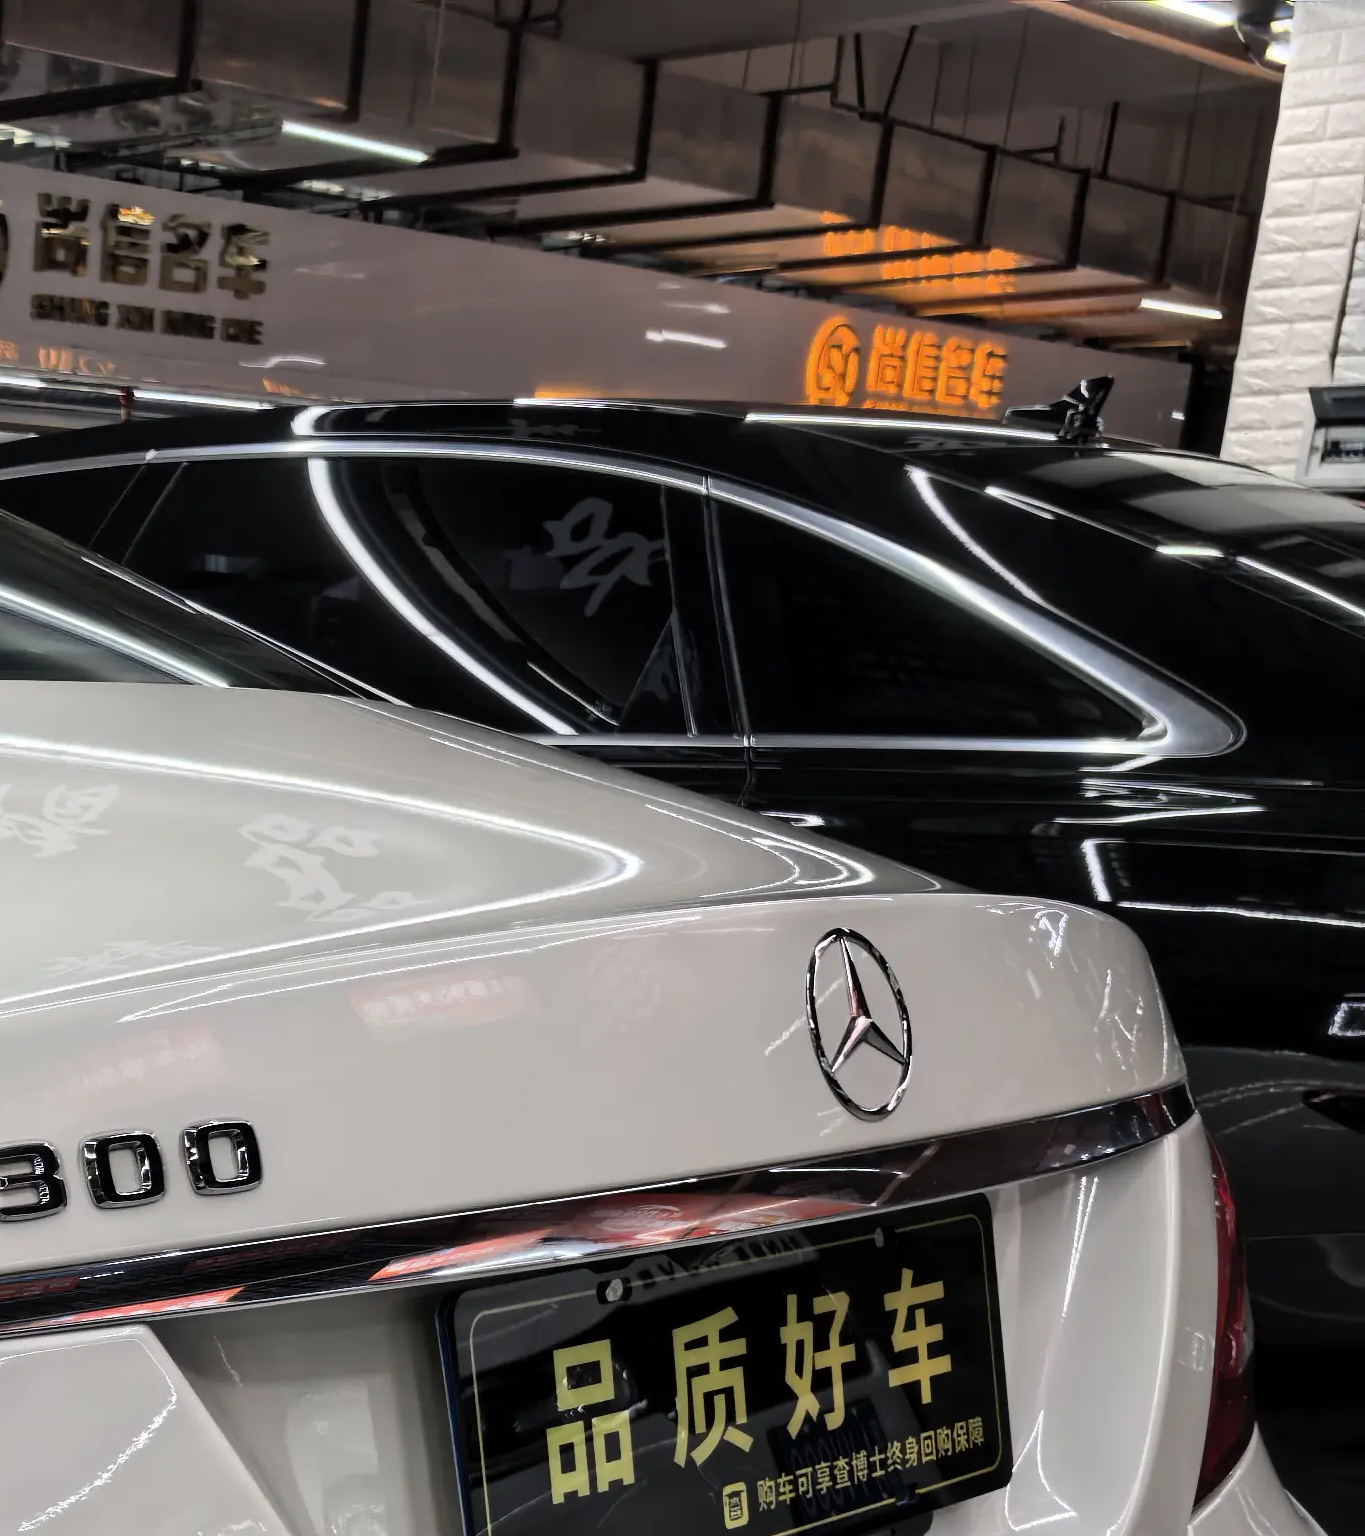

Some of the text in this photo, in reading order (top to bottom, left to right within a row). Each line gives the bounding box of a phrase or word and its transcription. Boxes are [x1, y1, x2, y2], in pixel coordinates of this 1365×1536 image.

[34, 191, 271, 300] 尚信名车
[867, 323, 1010, 409] 尚信名车
[545, 1267, 955, 1506] 品质好车
[756, 1416, 986, 1512] 购车可享查博士终身回购保障
